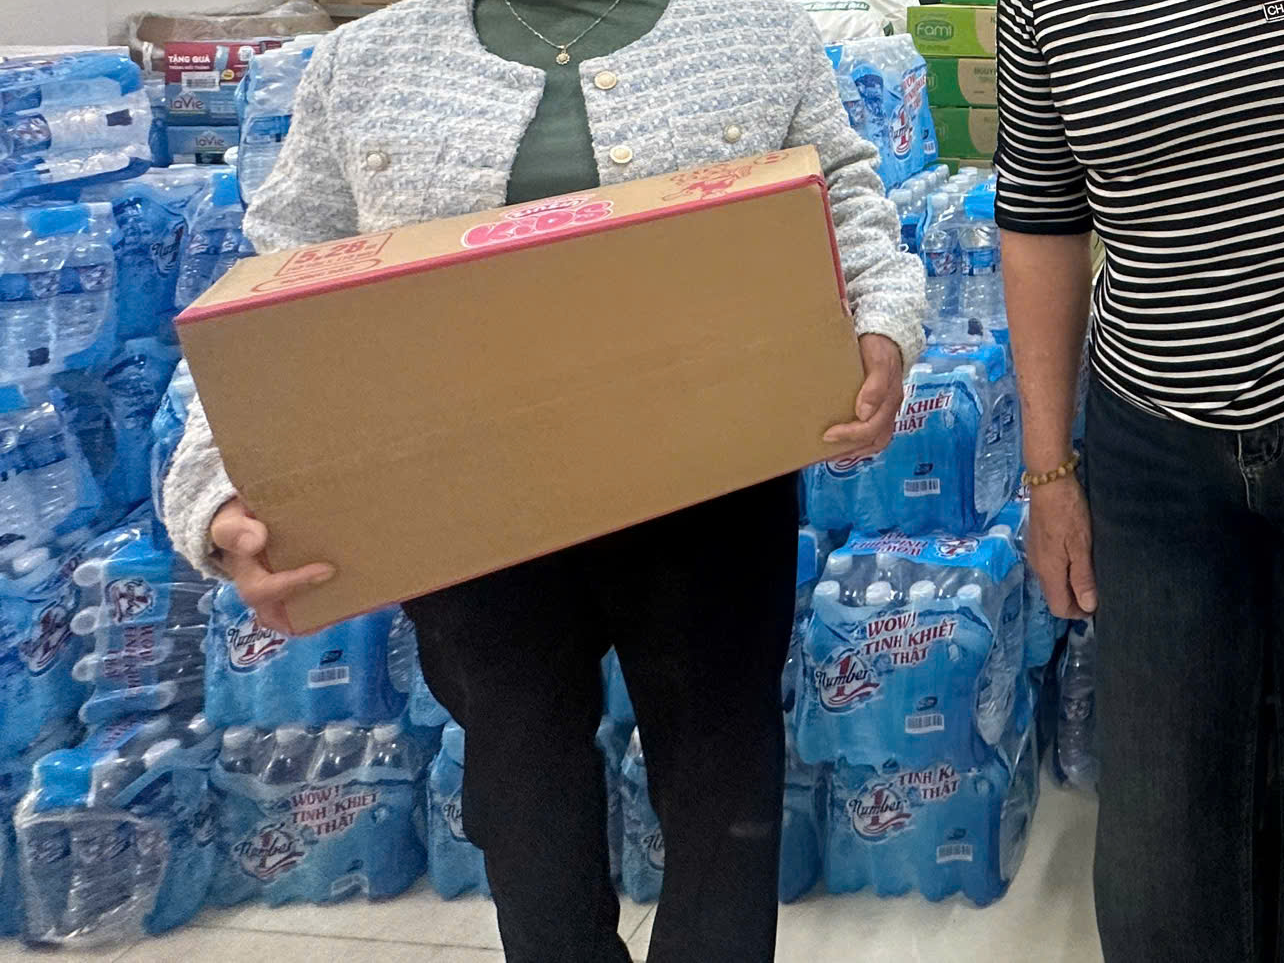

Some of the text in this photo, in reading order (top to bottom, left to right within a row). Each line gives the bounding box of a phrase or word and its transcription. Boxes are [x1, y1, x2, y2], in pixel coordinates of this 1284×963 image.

[916, 22, 953, 37] Fami
[867, 612, 917, 637] WOW!
[864, 618, 957, 655] TINH KHIẾT
[892, 647, 928, 665] THẬT
[815, 662, 873, 689] Number
[898, 771, 932, 786] TINH
[291, 786, 340, 807] WOW!
[848, 795, 908, 818] Number
[291, 807, 327, 824] TINH
